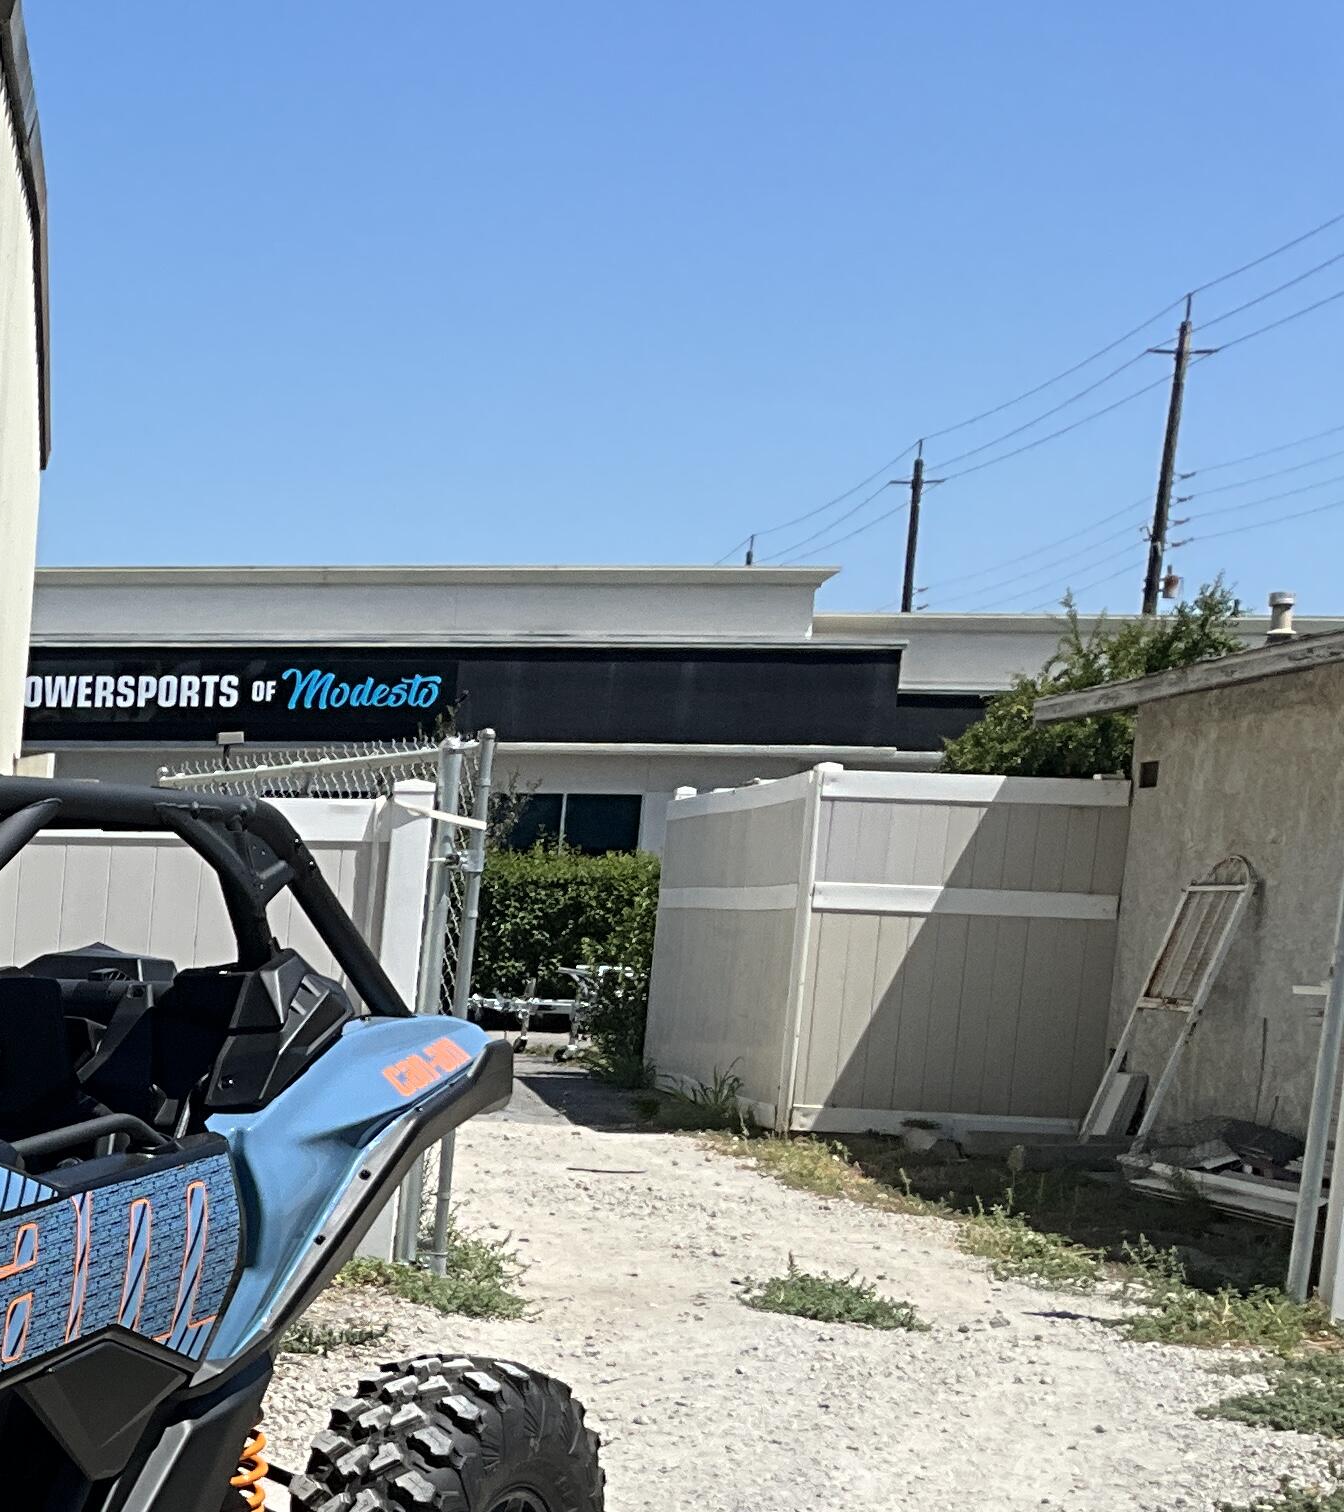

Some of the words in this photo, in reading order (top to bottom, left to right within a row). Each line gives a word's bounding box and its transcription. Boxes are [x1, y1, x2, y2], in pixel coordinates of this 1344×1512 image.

[23, 674, 239, 708] OWERSPORTS
[251, 680, 278, 702] OF
[282, 667, 442, 710] Modesto
